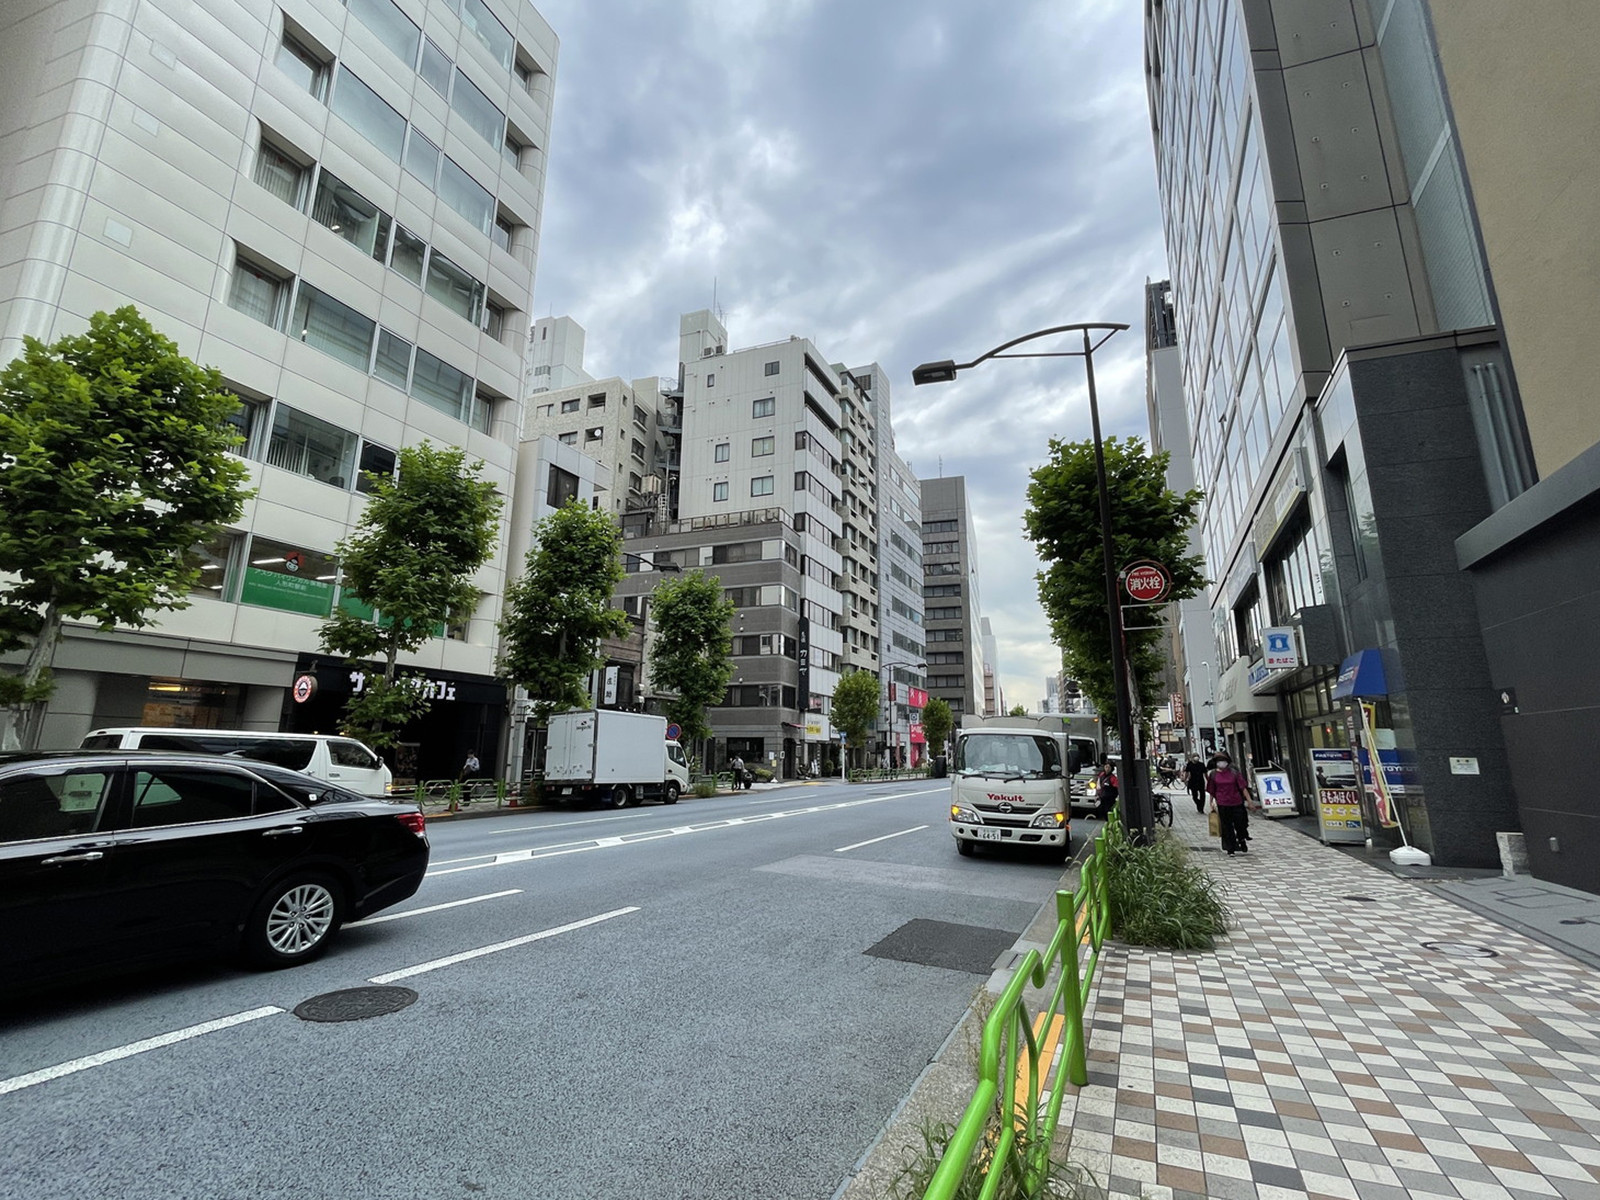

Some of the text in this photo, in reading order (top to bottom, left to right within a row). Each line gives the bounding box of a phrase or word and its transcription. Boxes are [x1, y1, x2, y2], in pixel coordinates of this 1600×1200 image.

[1130, 576, 1161, 591] 消火栓
[987, 793, 1025, 802] Yakult
